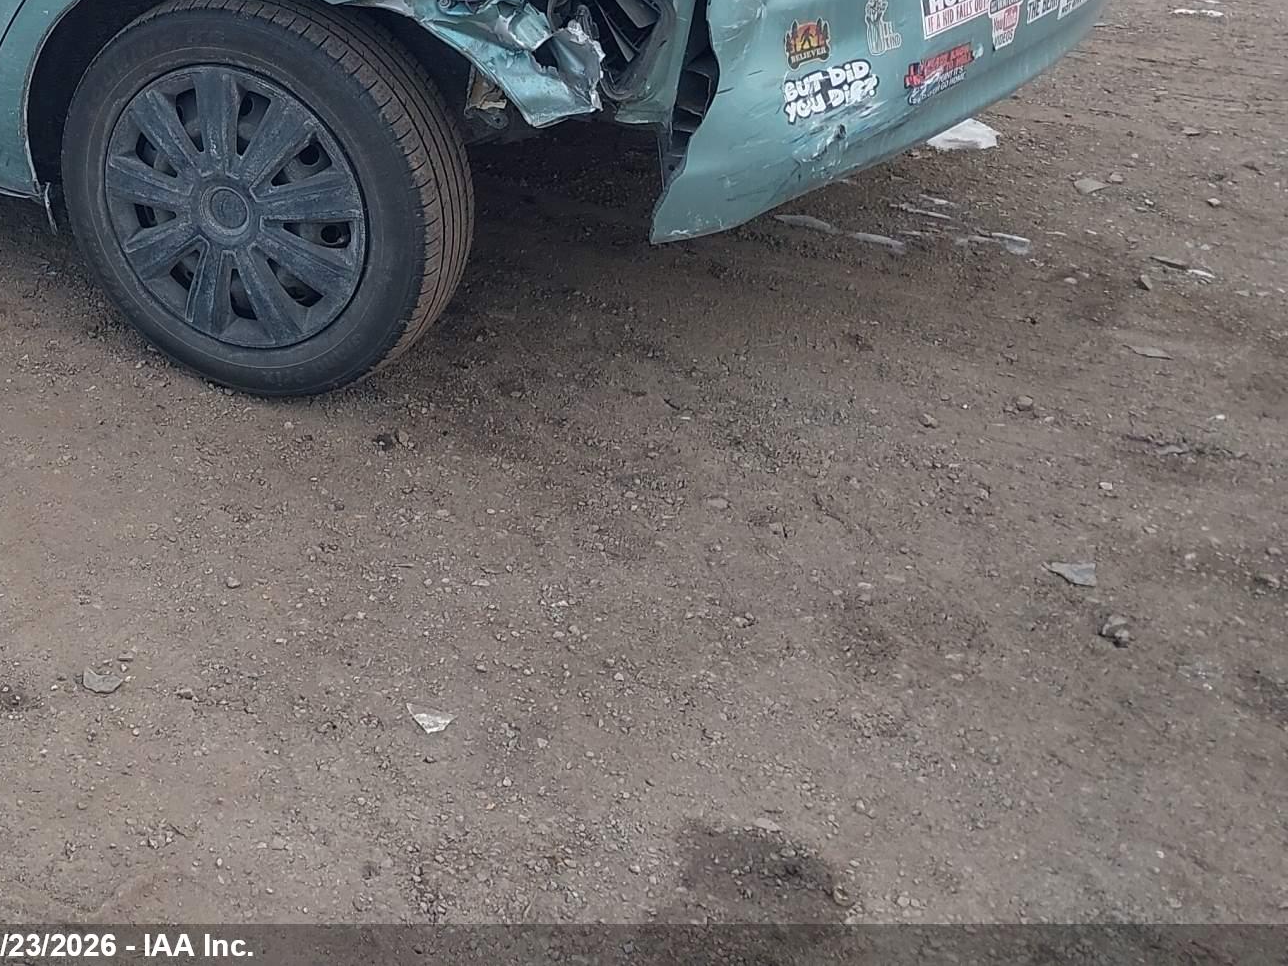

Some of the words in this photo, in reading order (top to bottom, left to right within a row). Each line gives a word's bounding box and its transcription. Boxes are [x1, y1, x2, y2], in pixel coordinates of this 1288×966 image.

[936, 13, 941, 30] A
[943, 8, 954, 26] KID
[955, 0, 973, 21] FALLS
[1028, 0, 1040, 22] THE
[994, 30, 1014, 46] VIDEOS
[790, 46, 827, 64] BELIEVER
[784, 72, 824, 102] BUT
[785, 92, 827, 123] YOU
